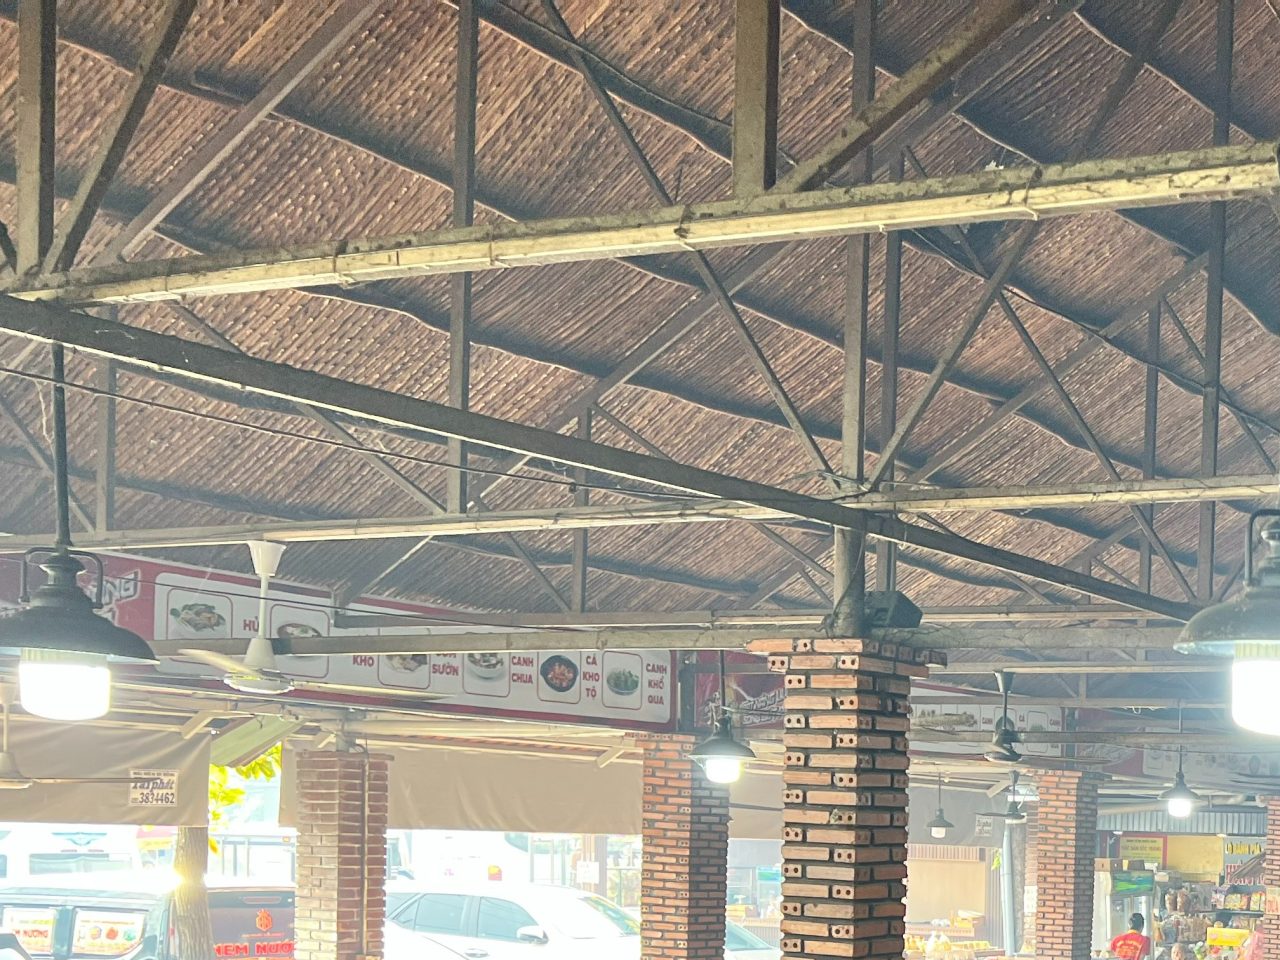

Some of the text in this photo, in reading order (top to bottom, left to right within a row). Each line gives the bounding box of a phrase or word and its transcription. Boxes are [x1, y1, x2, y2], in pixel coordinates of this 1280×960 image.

[352, 654, 375, 667] KHO
[511, 656, 534, 667] CANH
[645, 663, 667, 675] CANH
[511, 673, 534, 685] CHUA
[582, 671, 600, 682] KHO
[647, 694, 664, 705] QUA
